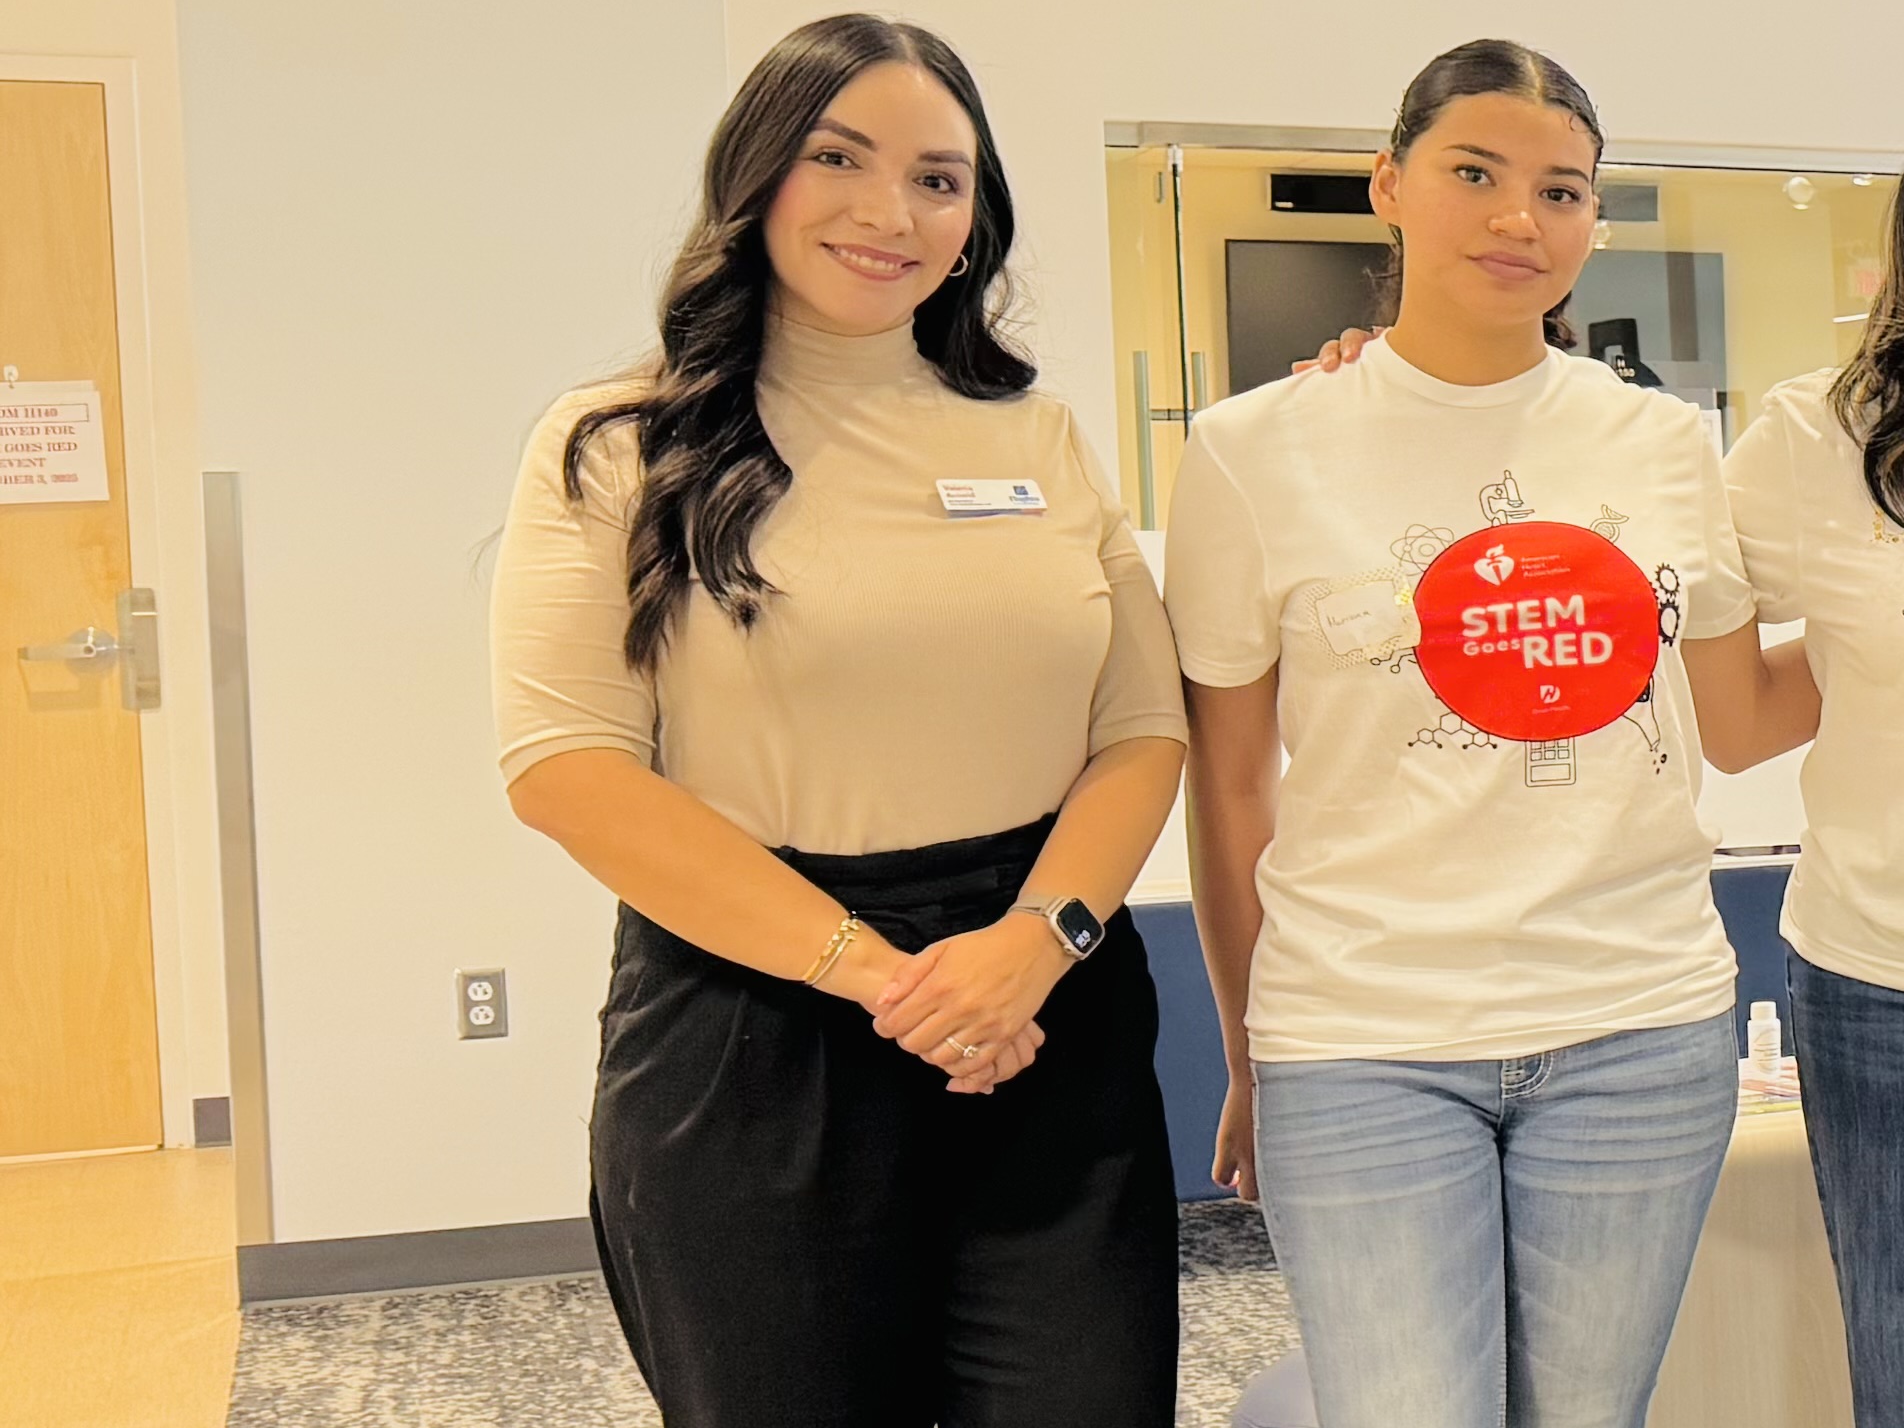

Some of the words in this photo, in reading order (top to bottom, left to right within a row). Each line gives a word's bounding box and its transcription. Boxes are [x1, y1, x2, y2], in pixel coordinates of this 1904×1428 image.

[44, 425, 76, 435] FOR
[4, 443, 42, 452] GOES
[47, 442, 78, 452] RED
[1461, 594, 1585, 638] STEM
[1463, 639, 1521, 656] Goes
[1522, 631, 1613, 669] RED
